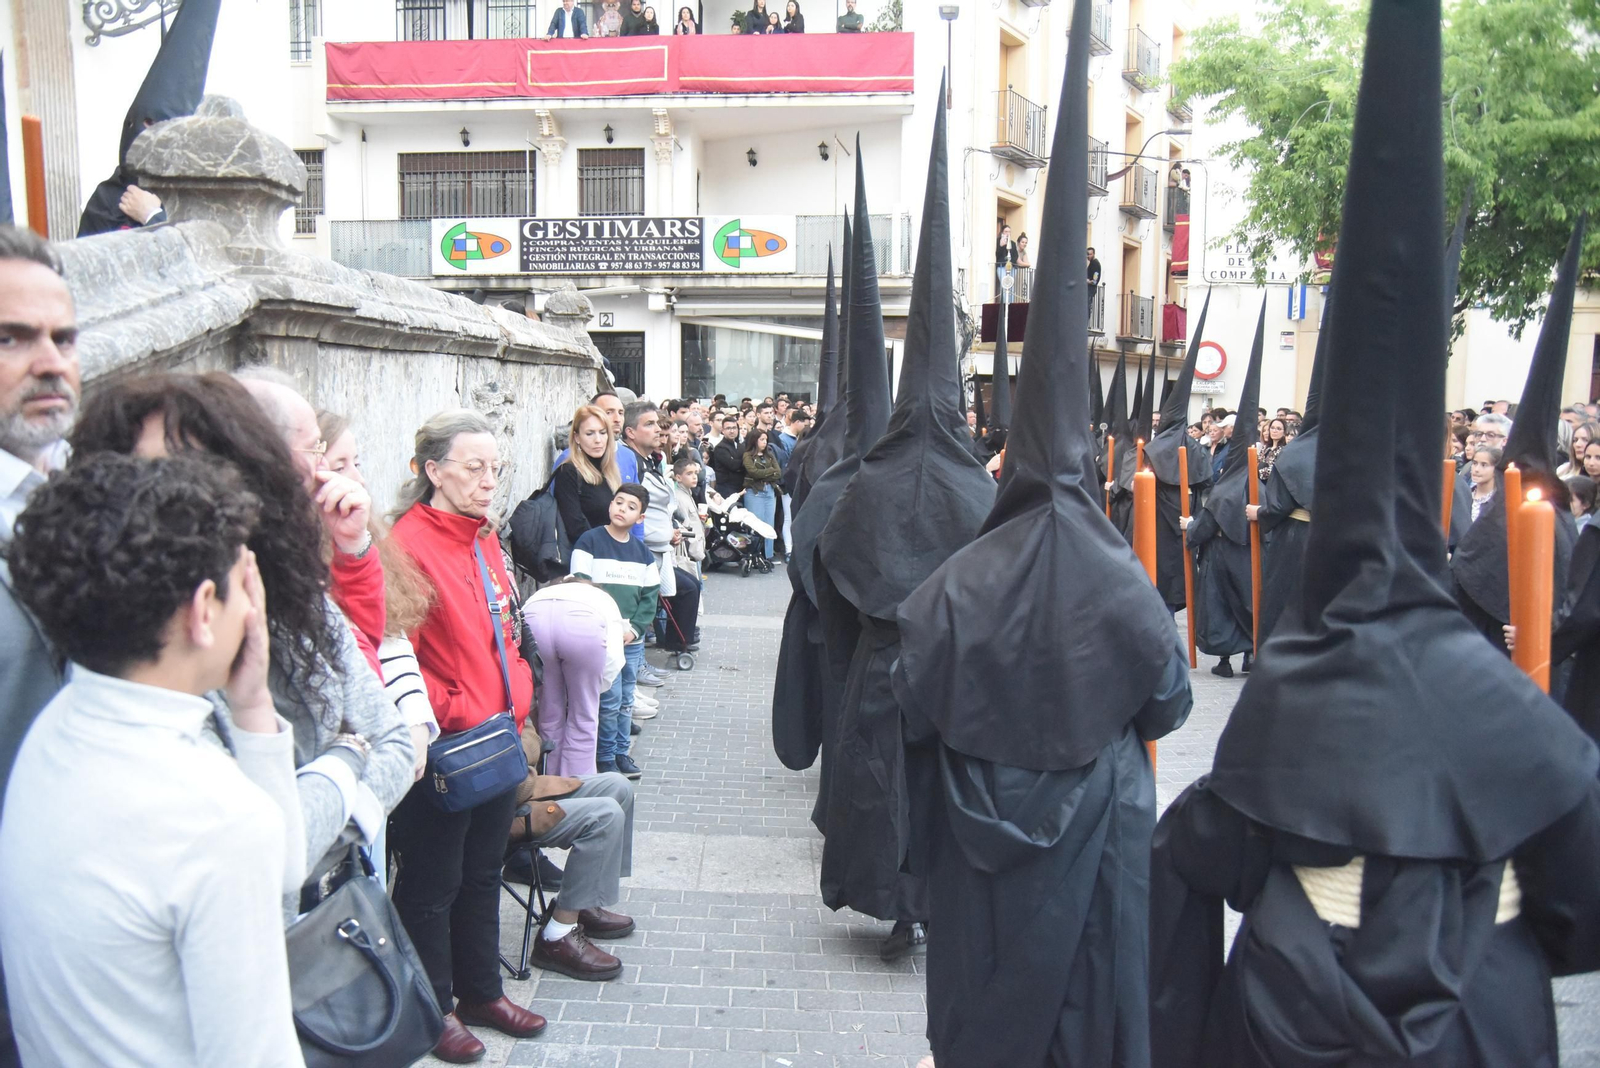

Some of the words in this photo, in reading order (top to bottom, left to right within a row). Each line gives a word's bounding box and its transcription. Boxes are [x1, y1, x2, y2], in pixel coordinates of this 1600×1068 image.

[522, 219, 700, 239] GESTIMARS
[529, 252, 567, 261] GESTIÓN
[568, 253, 612, 261] INTEGRAL
[627, 252, 700, 260] TRANSACCIONES
[529, 262, 595, 270] INMOBILIARIAS
[658, 261, 671, 269] 957
[672, 261, 680, 269] 48
[681, 261, 690, 269] 83
[691, 261, 700, 269] 94
[1228, 257, 1245, 267] DE
[1210, 270, 1287, 280] COMPAIA
[602, 314, 611, 326] 2
